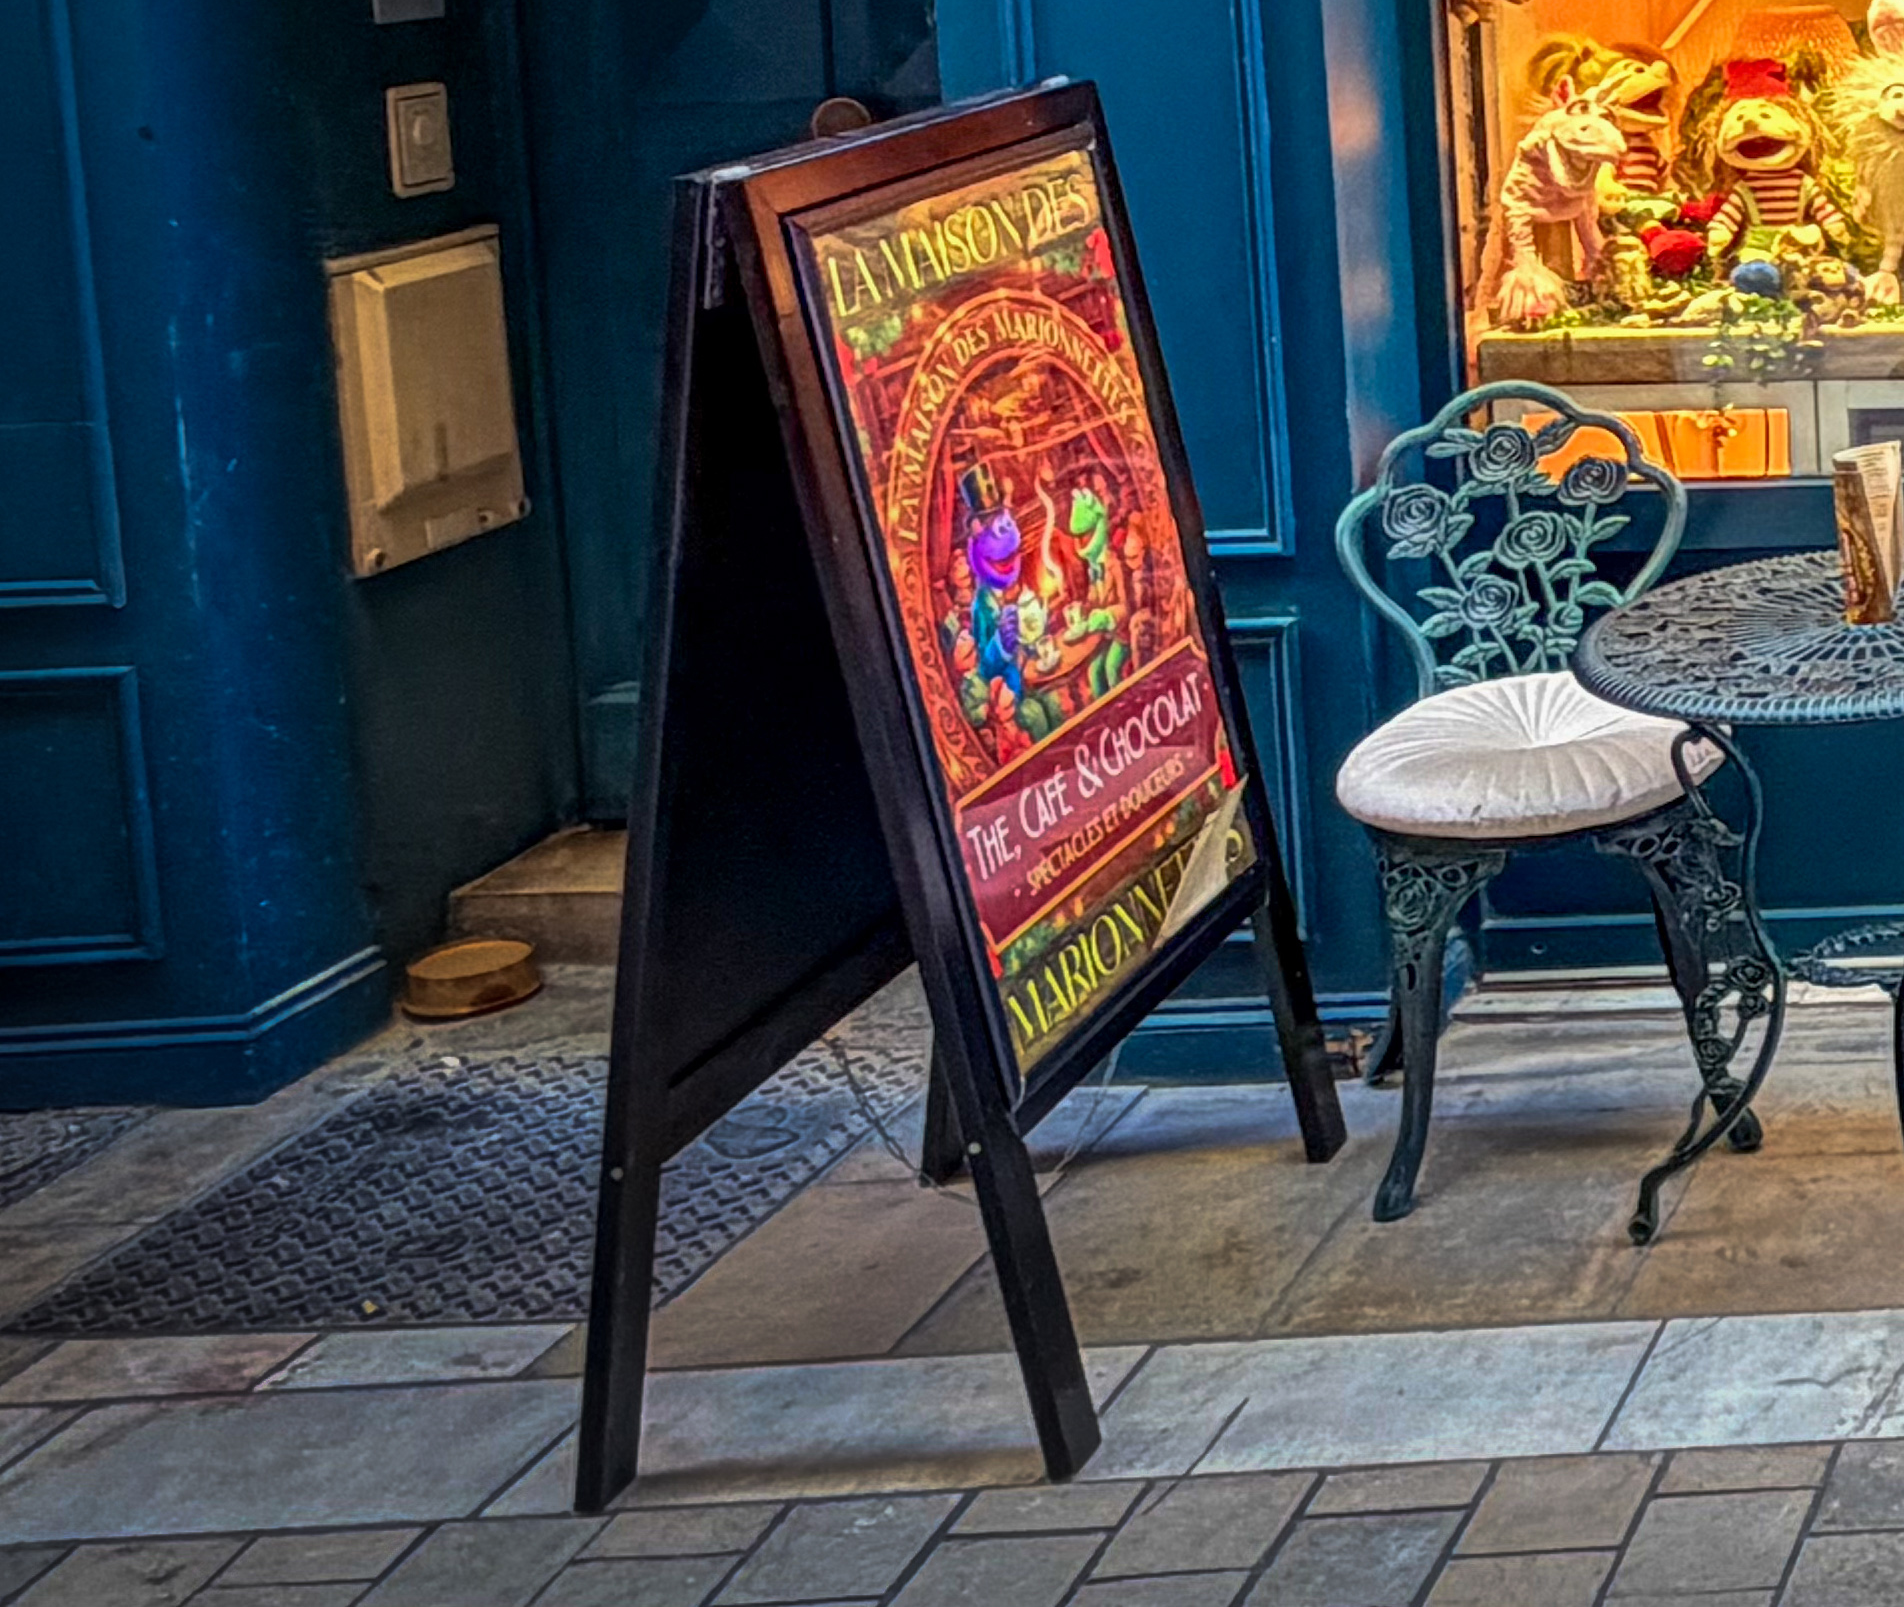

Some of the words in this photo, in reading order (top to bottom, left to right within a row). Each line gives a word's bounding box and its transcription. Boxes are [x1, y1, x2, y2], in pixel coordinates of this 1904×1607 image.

[828, 249, 883, 318] LA
[879, 193, 1024, 298] MAISON
[1021, 173, 1092, 250] DES
[906, 353, 961, 483] MAISON
[951, 325, 992, 368] DES
[994, 311, 1138, 426] MARIONNETTES
[1018, 764, 1075, 839] CAFÉ
[1074, 744, 1104, 799] &
[1099, 672, 1204, 777] CHOCOLAT
[1030, 820, 1103, 896] SPECTACLES
[1101, 802, 1122, 835] ET
[1118, 752, 1185, 820] DOUCEURS
